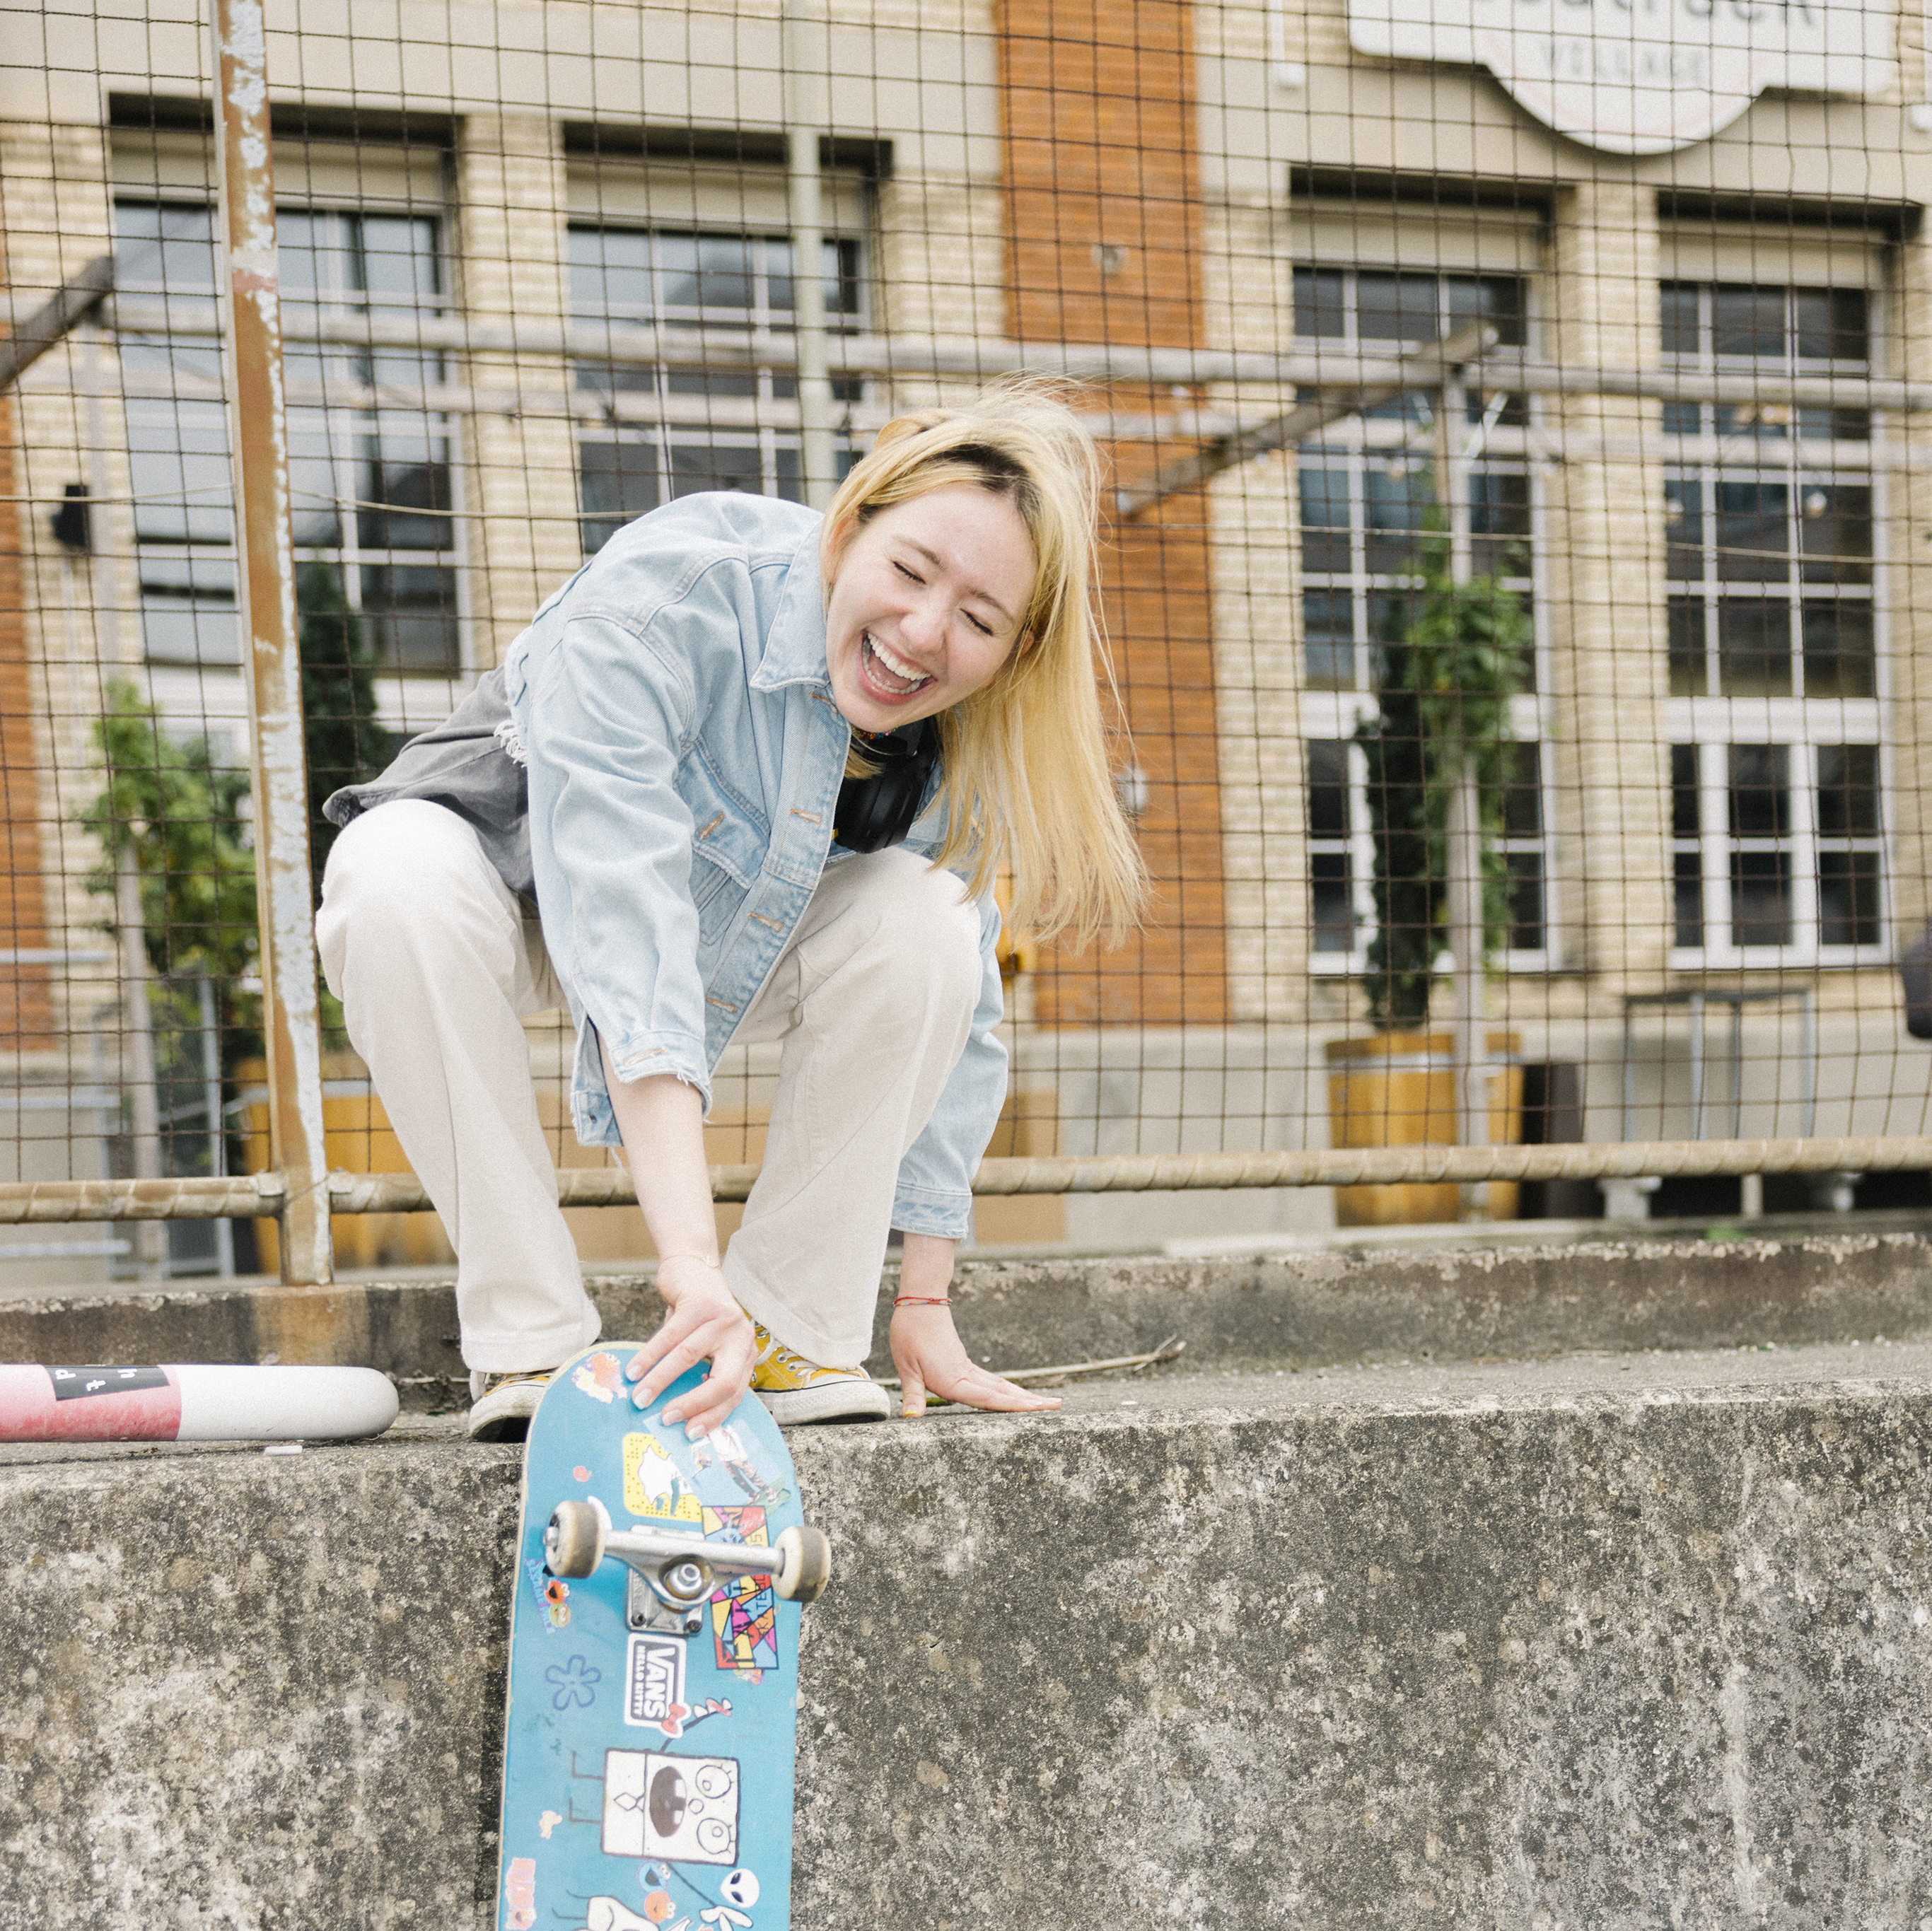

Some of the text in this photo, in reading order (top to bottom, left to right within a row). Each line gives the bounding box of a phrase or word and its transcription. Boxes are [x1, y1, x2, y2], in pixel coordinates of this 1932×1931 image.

[633, 1645, 646, 1716] HELLO KITTY
[642, 1647, 676, 1718] VANS
